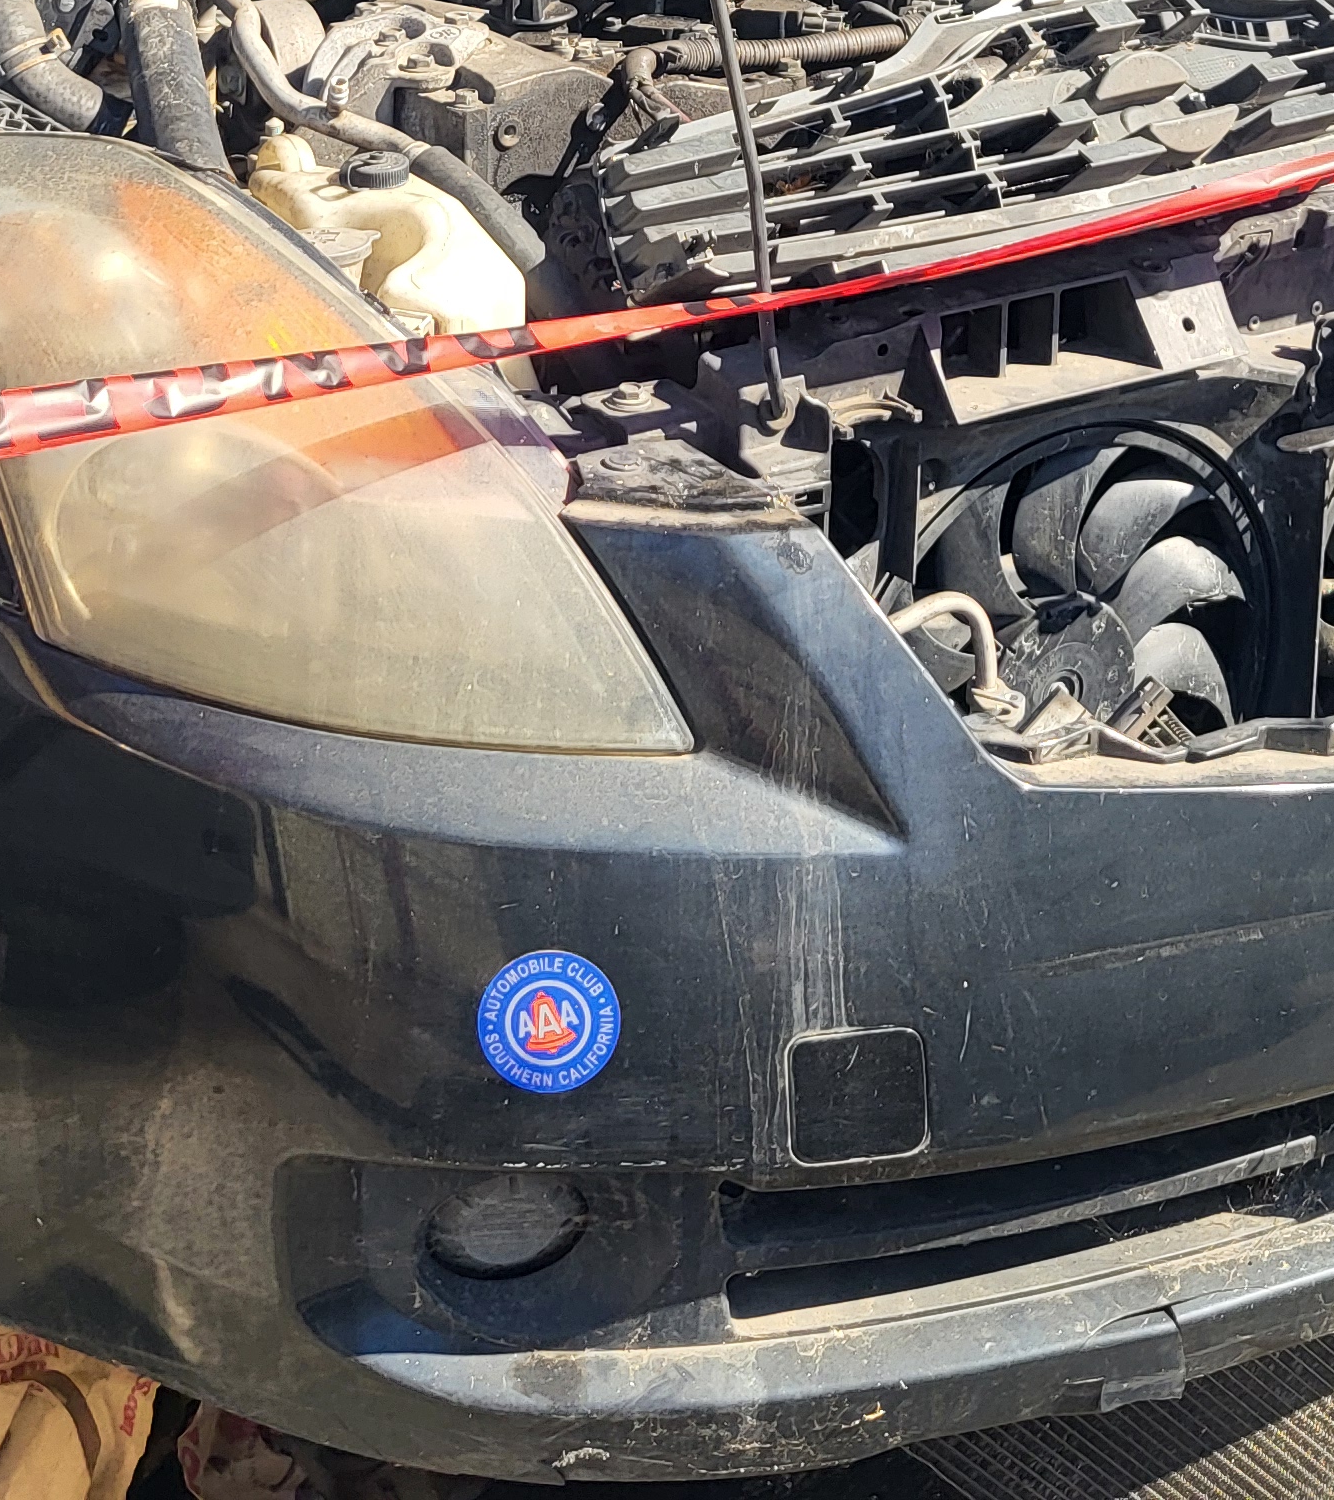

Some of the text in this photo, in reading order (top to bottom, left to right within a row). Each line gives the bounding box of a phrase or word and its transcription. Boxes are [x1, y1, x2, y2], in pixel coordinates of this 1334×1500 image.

[483, 957, 605, 1023] AUTOMOBILE CLUB
[518, 999, 580, 1039] AAA
[484, 1005, 615, 1088] SOUTHERN CALIFORNIA
